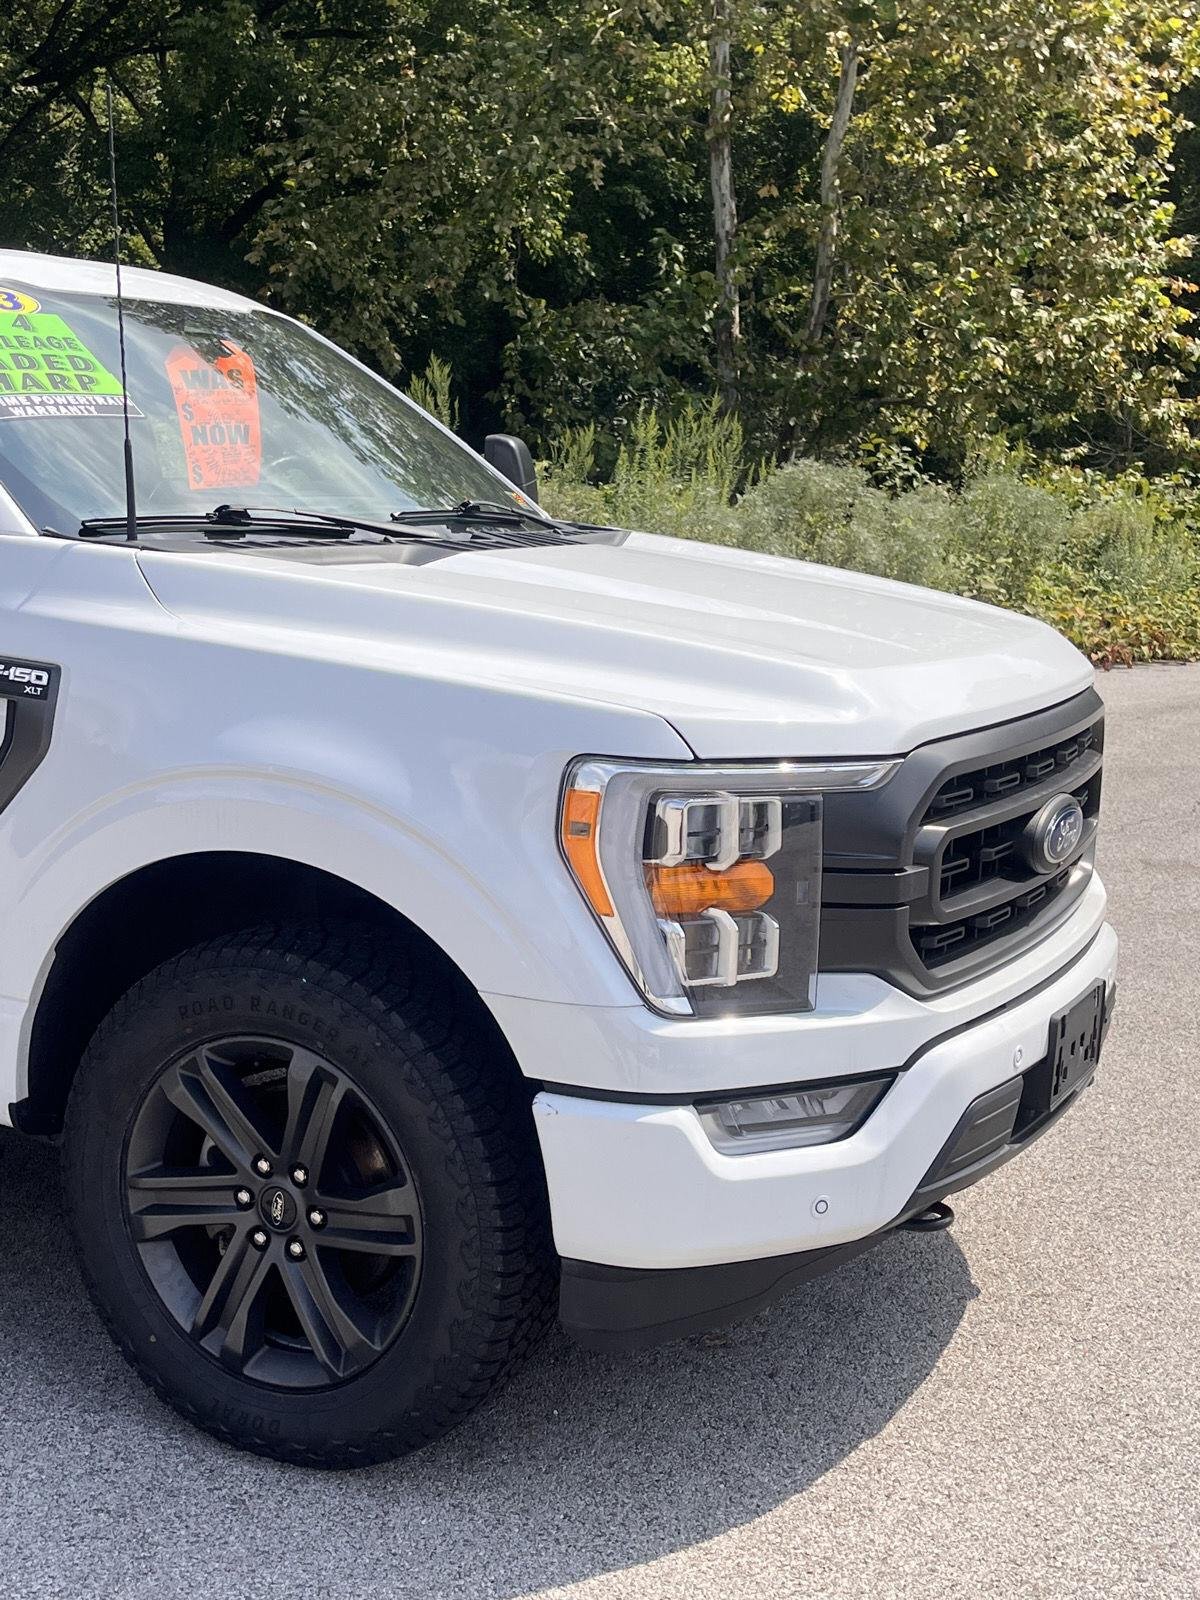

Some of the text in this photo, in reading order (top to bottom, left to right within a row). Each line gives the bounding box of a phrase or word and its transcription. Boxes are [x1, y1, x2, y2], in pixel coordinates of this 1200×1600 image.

[179, 368, 246, 390] WAS
[8, 405, 98, 416] WARRANTY
[181, 401, 194, 422] $
[191, 424, 250, 446] NOW
[192, 463, 204, 484] $
[23, 685, 44, 696] XLT
[178, 995, 235, 1020] ROAD
[251, 995, 341, 1042] RANGER
